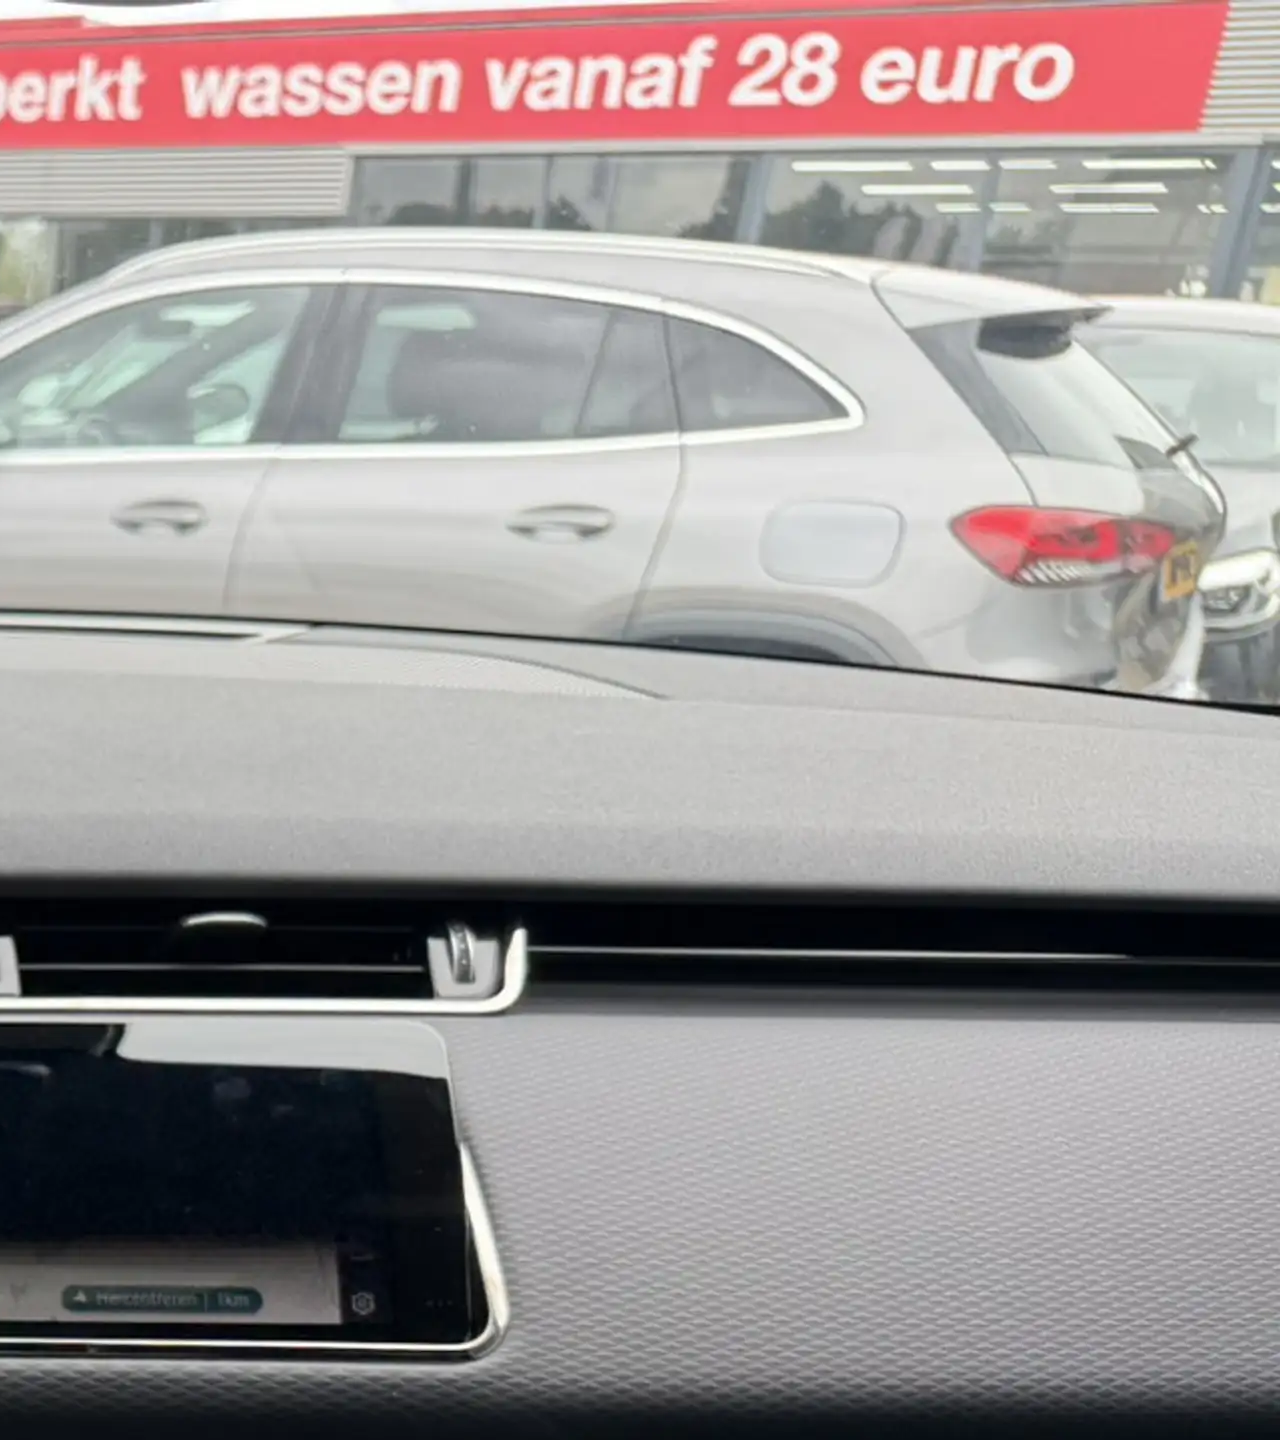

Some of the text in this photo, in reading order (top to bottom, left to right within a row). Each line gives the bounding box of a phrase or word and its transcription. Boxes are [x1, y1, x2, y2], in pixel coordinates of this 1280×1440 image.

[182, 52, 461, 118] wassen
[484, 36, 718, 111] vanaf
[729, 31, 840, 107] 28
[860, 42, 1075, 104] euro
